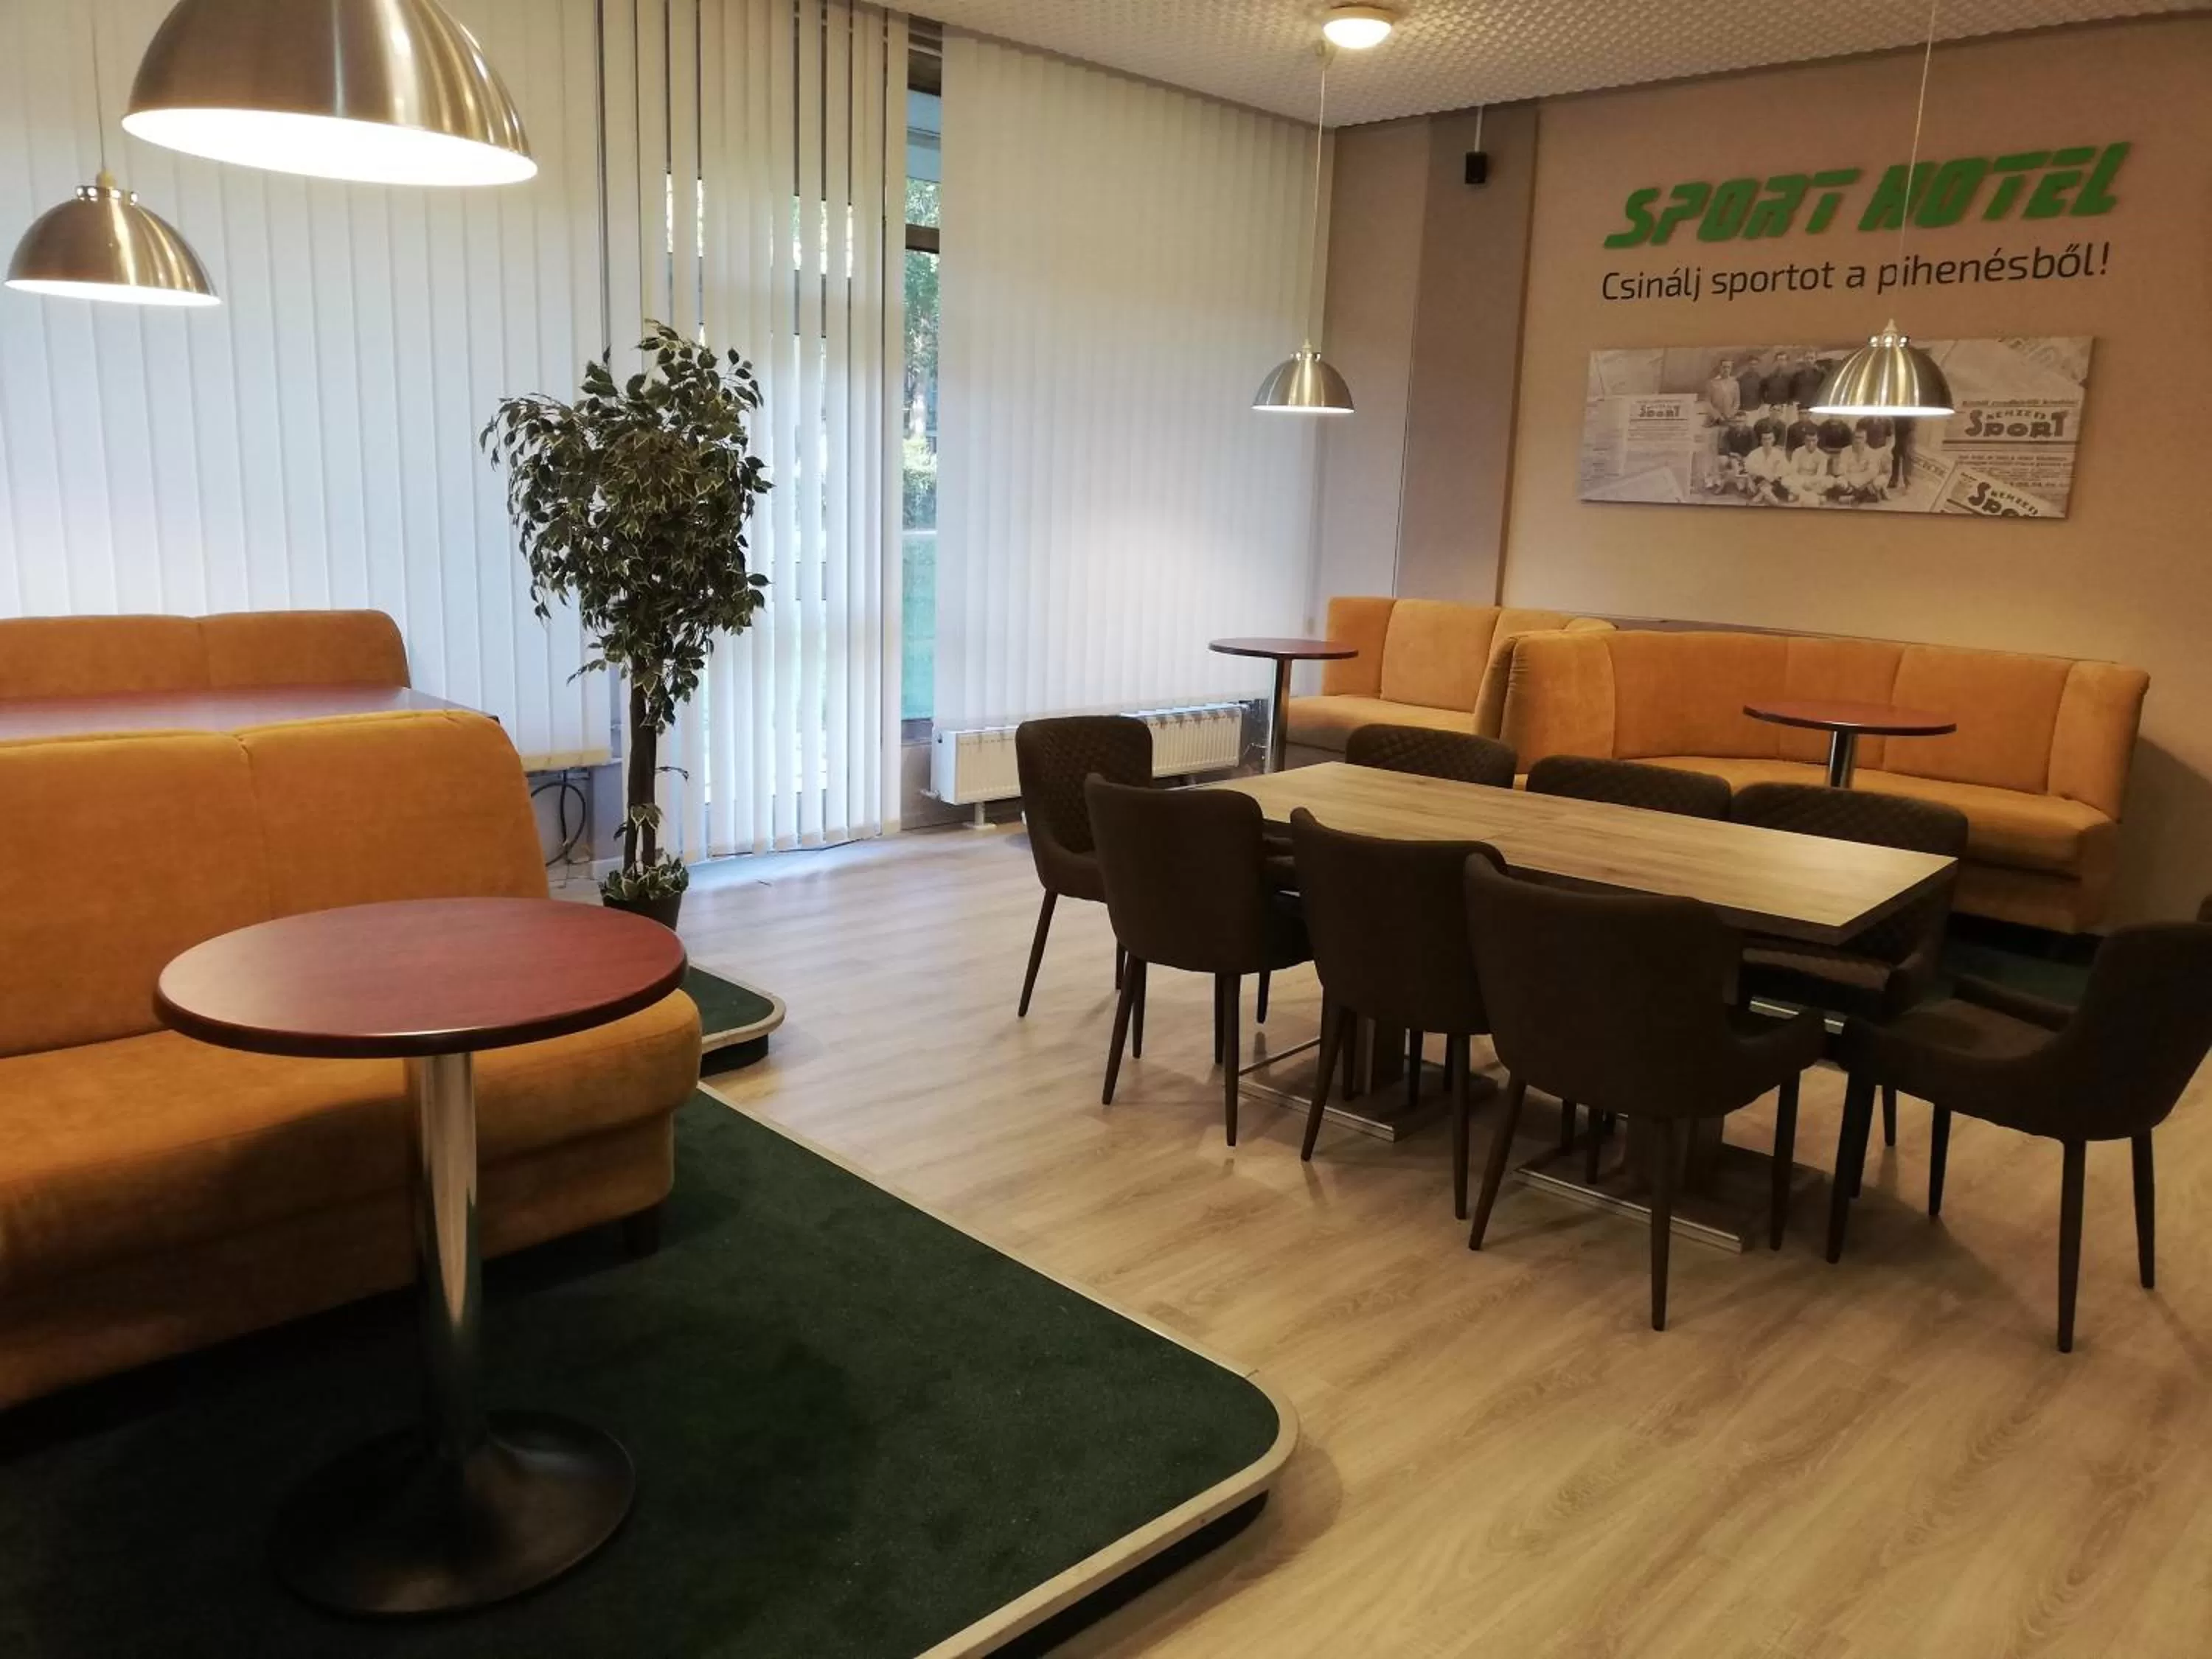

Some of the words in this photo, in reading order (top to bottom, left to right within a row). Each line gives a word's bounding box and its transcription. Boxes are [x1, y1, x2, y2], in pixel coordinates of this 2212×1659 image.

[1603, 167, 1864, 249] SPORT
[1857, 141, 2132, 232] HOTEL
[1601, 267, 1700, 302] Csinálj
[1711, 260, 1835, 301] sportot
[1846, 263, 1865, 287] a
[1877, 242, 2110, 294] pihenésből!
[1964, 409, 2068, 438] SPORT
